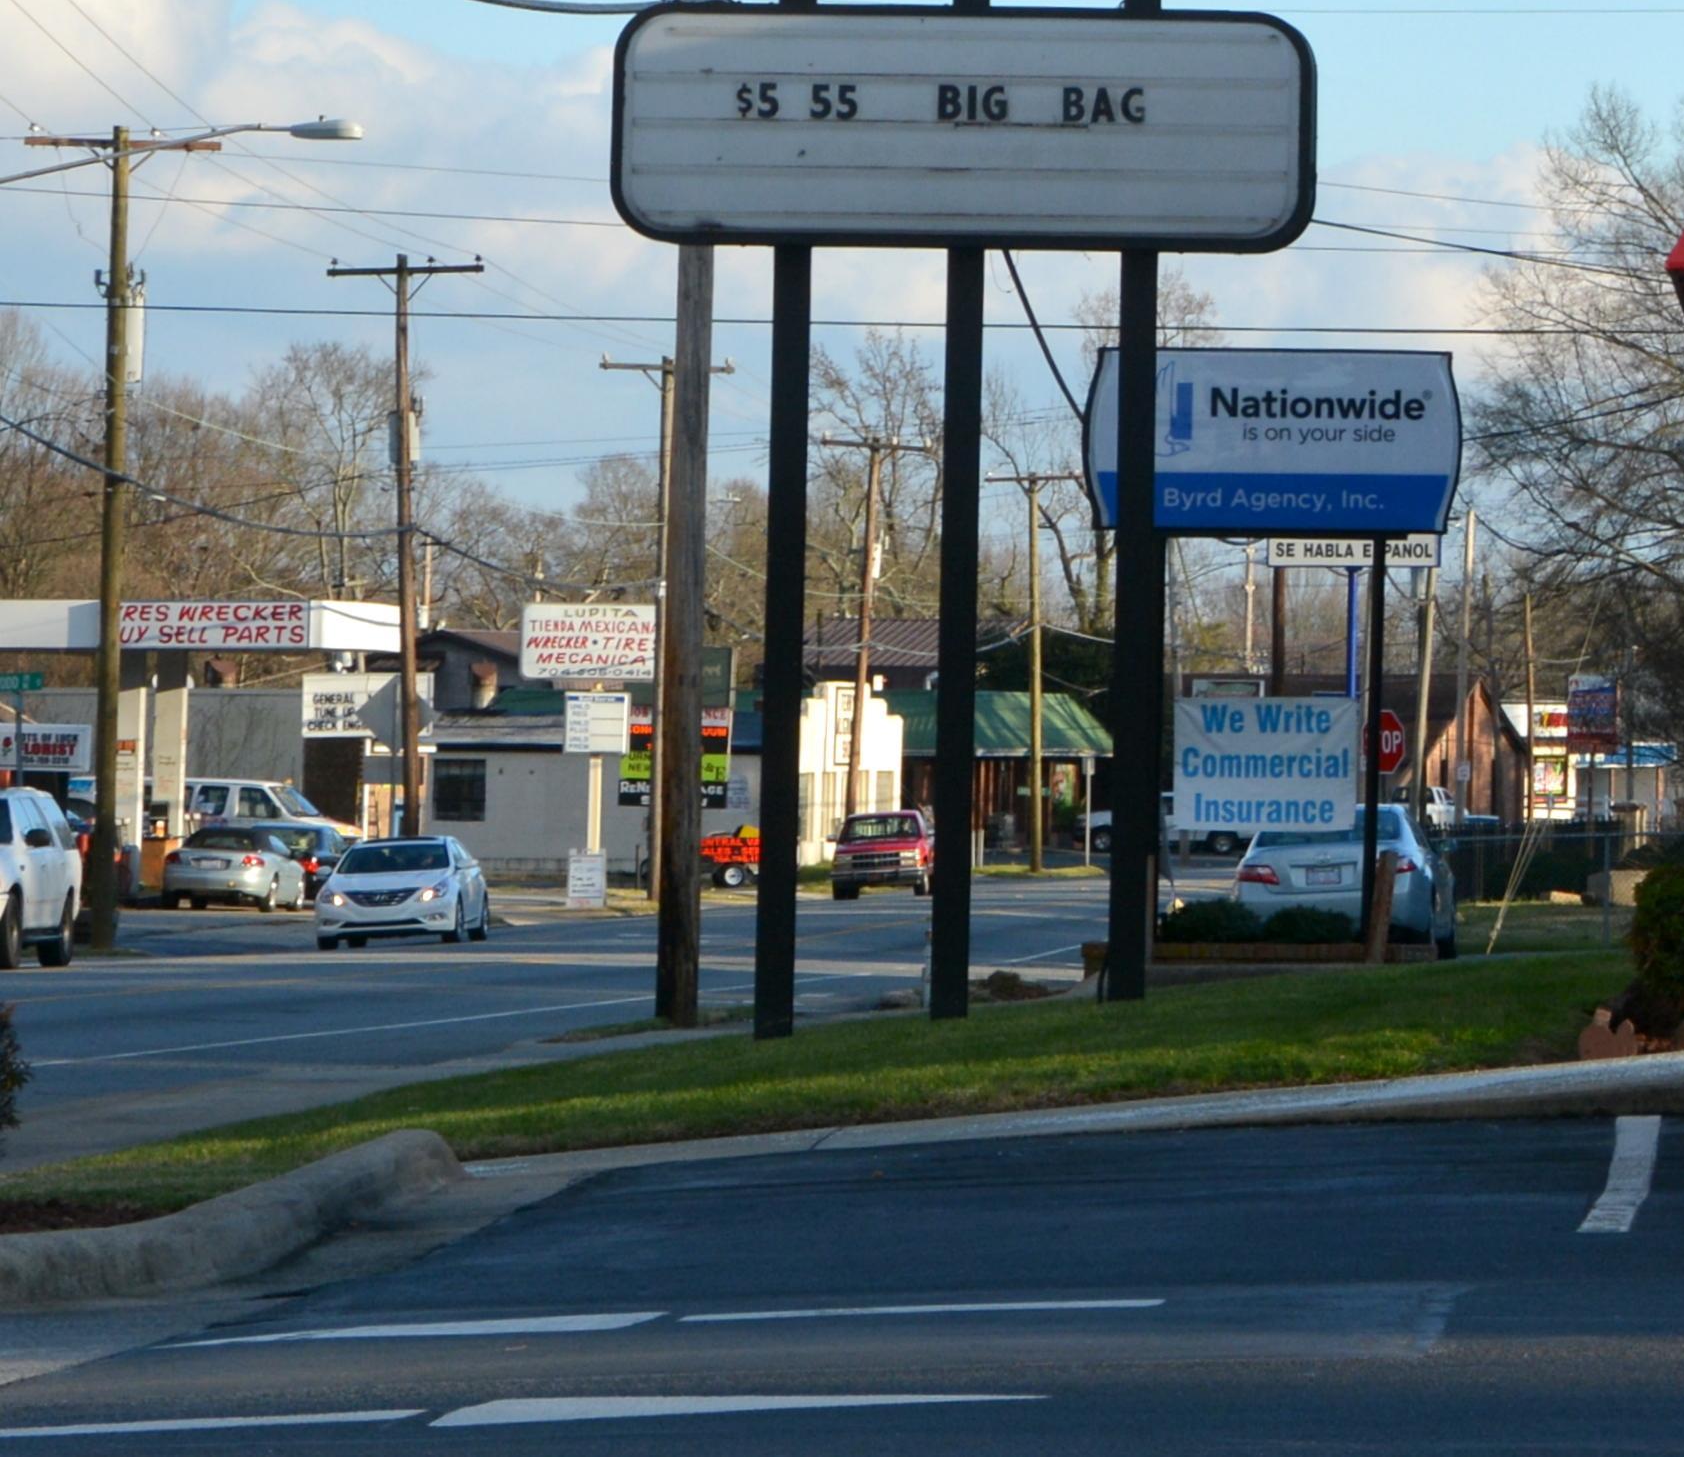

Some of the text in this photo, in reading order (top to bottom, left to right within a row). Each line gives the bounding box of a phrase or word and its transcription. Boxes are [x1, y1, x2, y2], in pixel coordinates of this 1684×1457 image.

[735, 82, 1146, 124] $5 55 BIG BAG
[1242, 423, 1396, 446] is on your side
[1163, 488, 1385, 513] Byrd Agency, Inc.
[1275, 543, 1433, 559] SE HABLA EPANOL
[120, 604, 304, 622] RES WRECKER
[563, 607, 639, 618] LUPITA
[119, 625, 305, 644] UY SELL PARTS
[529, 619, 576, 633] TIENDA
[526, 635, 656, 652] WRECKER TIRE
[535, 651, 647, 666] MECANICA
[312, 692, 356, 705] GENERAL
[314, 706, 337, 719] TUNE
[1200, 703, 1332, 735] We Write
[23, 743, 77, 755] LORIST
[1182, 746, 1350, 779] Commercial
[1194, 793, 1335, 824] Insurance
